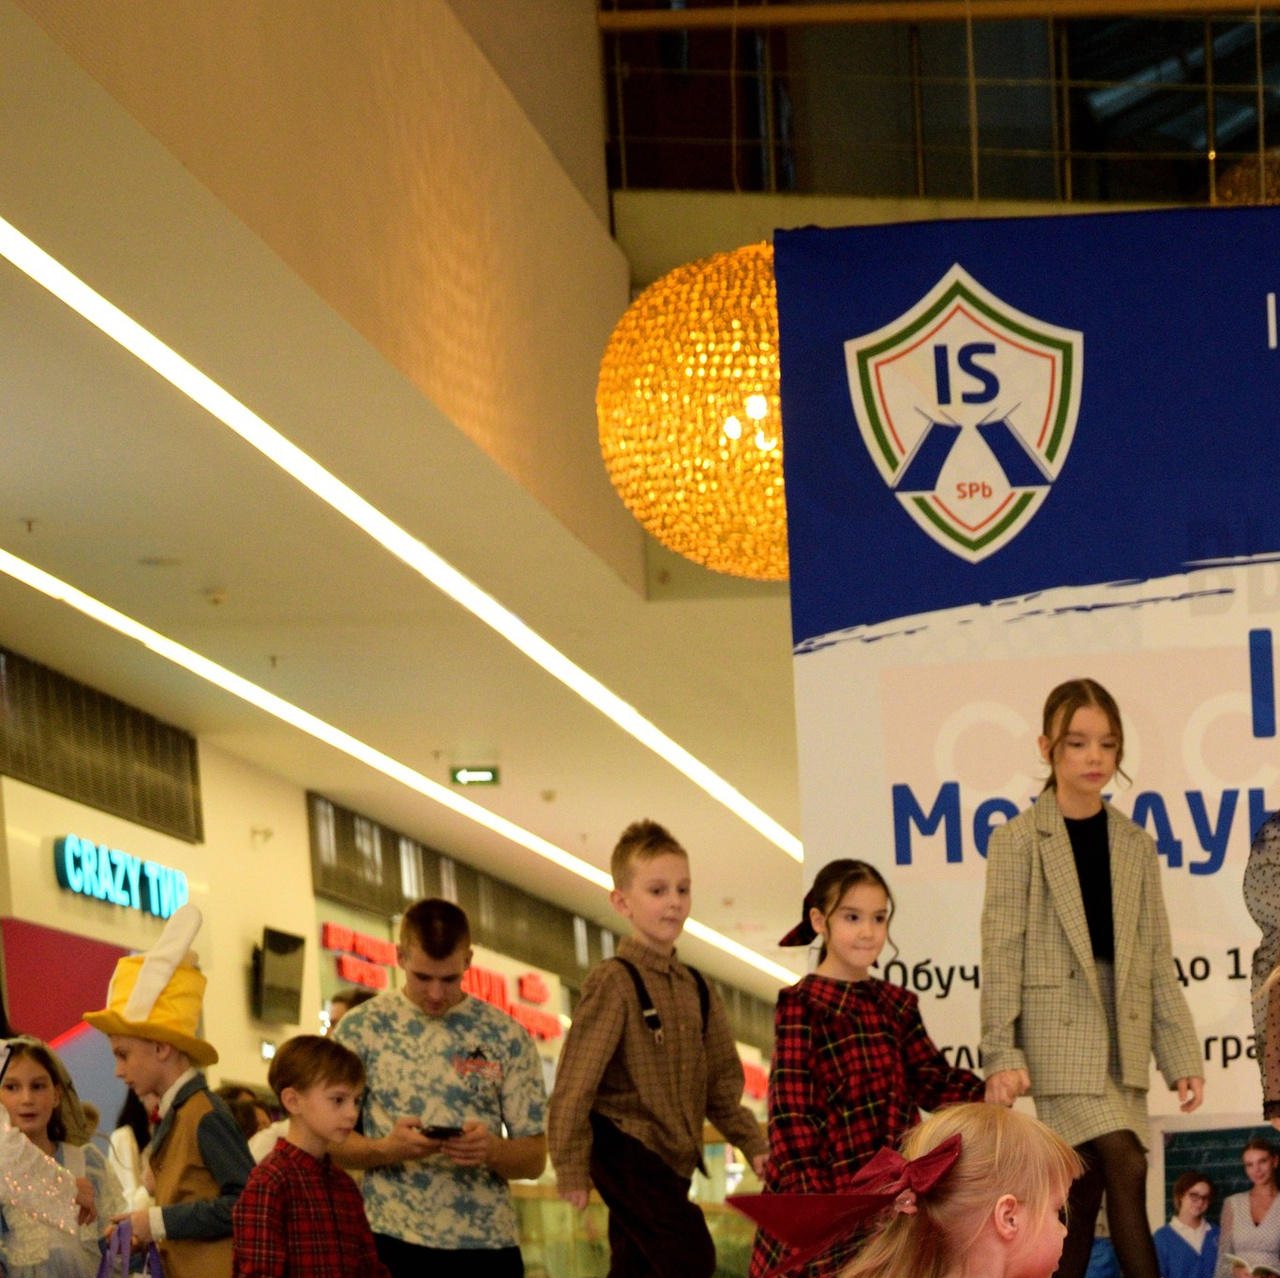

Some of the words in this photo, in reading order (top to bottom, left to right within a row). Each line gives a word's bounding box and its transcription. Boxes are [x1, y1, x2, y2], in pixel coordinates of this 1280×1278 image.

[933, 342, 1001, 407] IS
[955, 481, 994, 501] SPb
[64, 833, 141, 910] CRAZY
